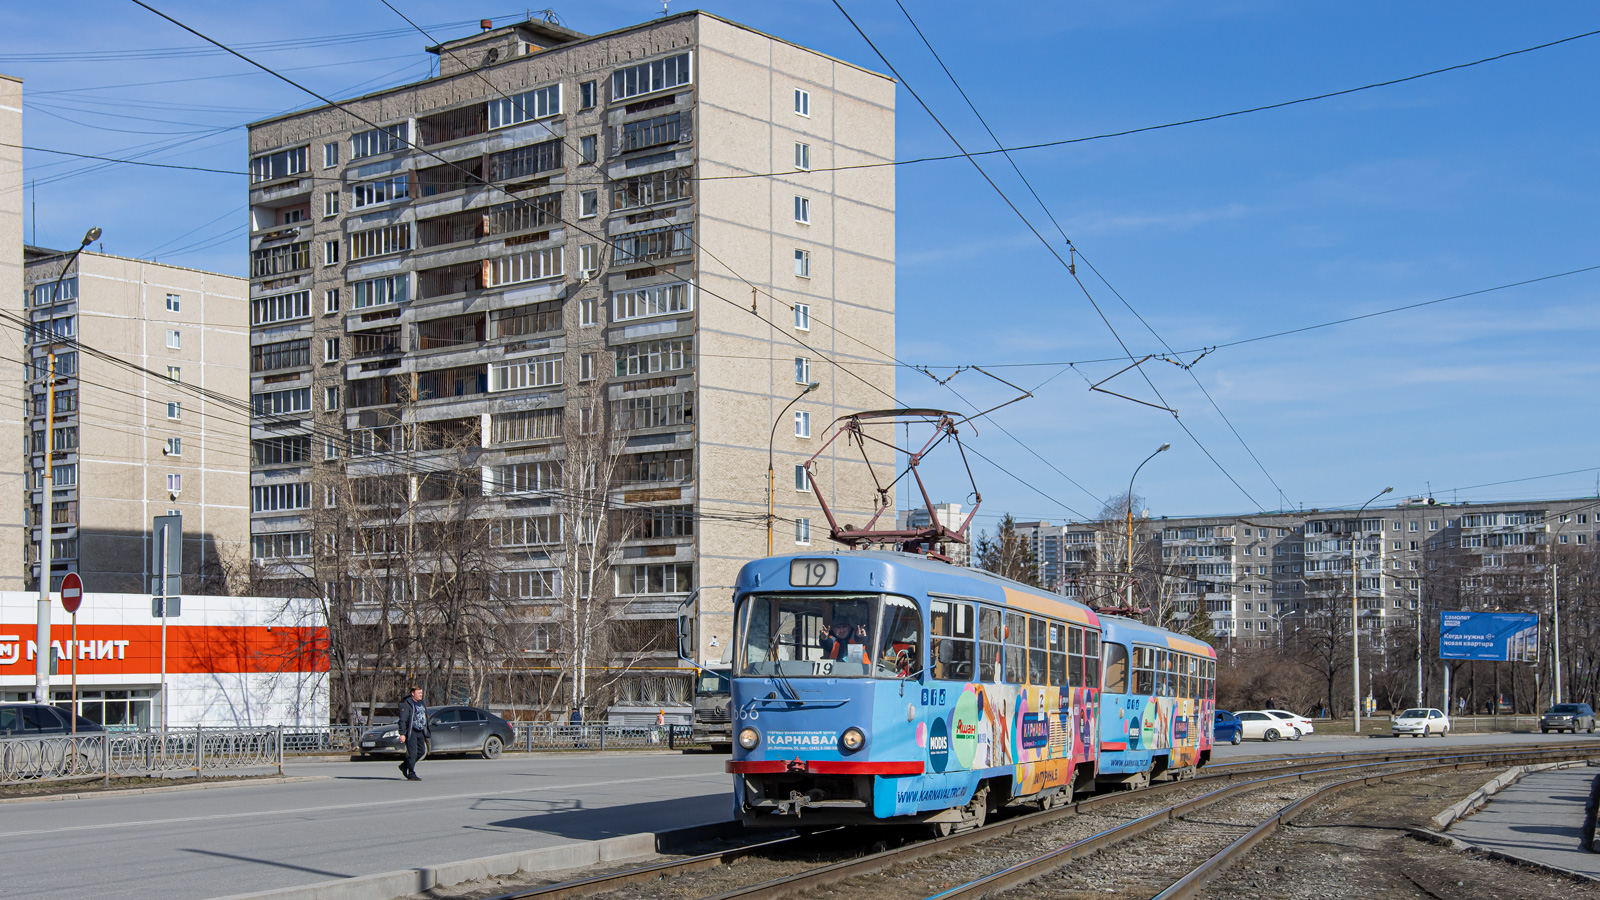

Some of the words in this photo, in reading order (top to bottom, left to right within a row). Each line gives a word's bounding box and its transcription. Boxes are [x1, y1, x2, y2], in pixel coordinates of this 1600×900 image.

[804, 562, 827, 586] 19
[813, 662, 833, 676] 19
[767, 735, 838, 745] КАРНАВАЛ
[930, 736, 948, 751] MODIS
